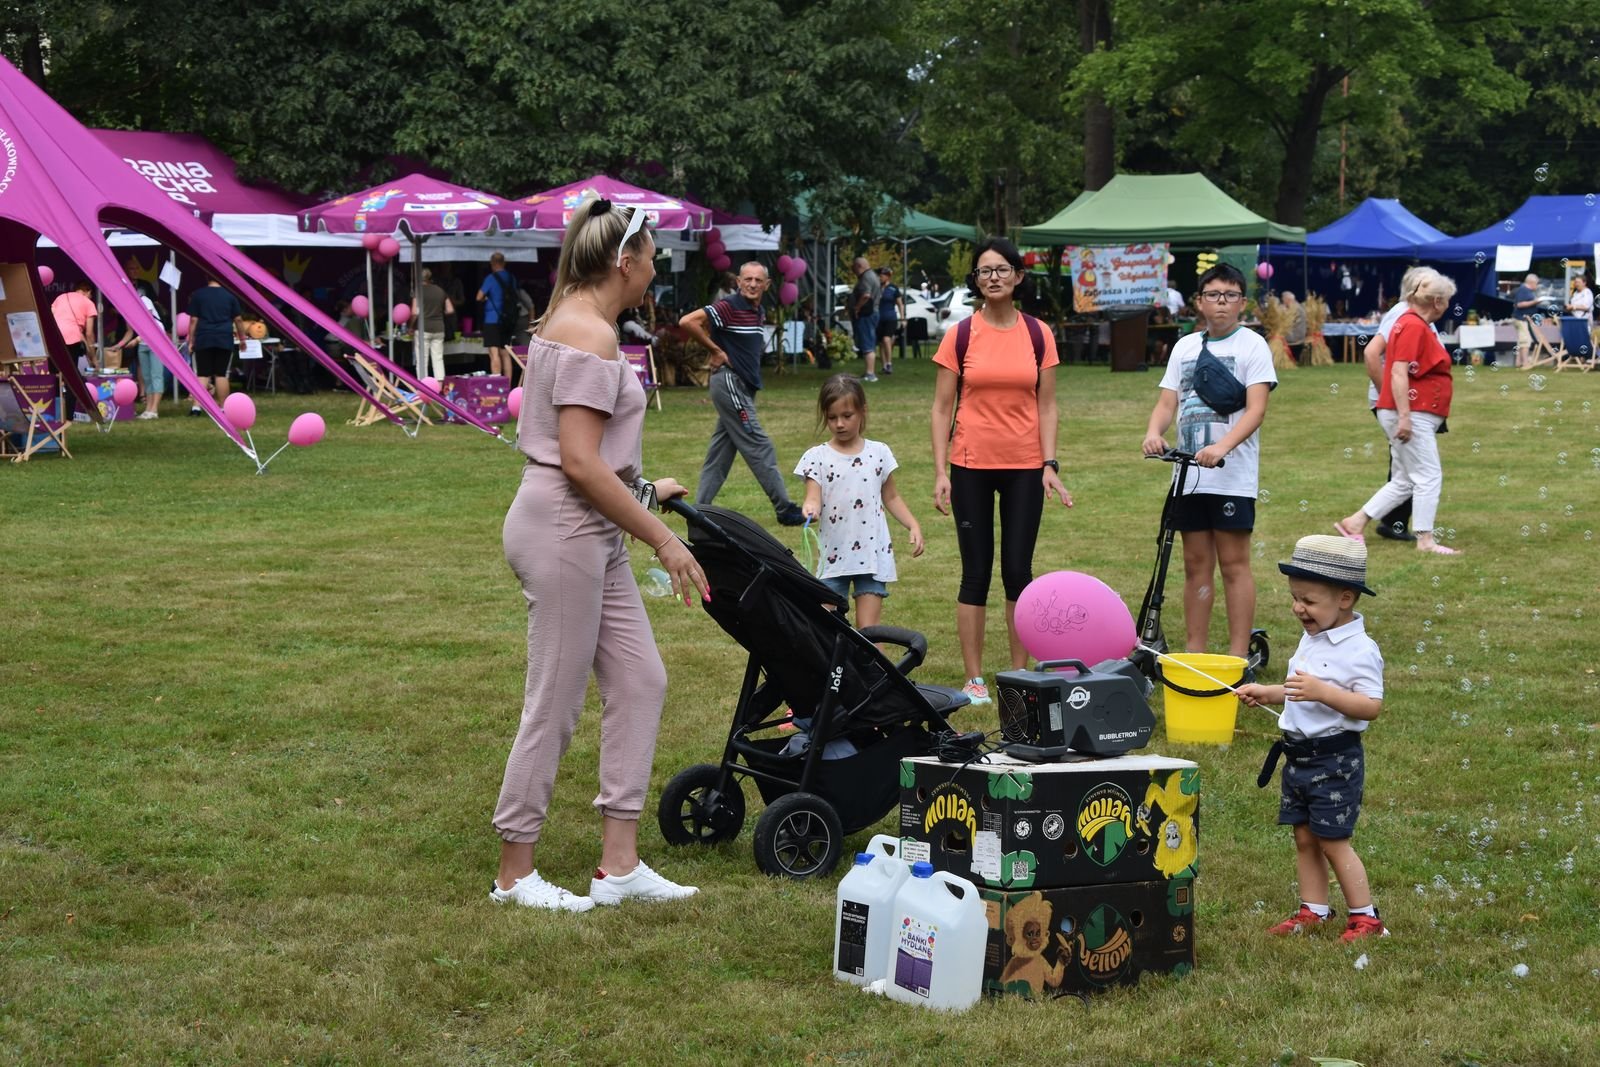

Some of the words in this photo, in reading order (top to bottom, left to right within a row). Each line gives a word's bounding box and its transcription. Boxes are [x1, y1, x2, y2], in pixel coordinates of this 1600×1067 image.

[830, 665, 844, 693] Joie
[1098, 731, 1138, 741] BUBBLETRON
[1077, 797, 1134, 839] yellow
[900, 936, 932, 956] MYDLANE
